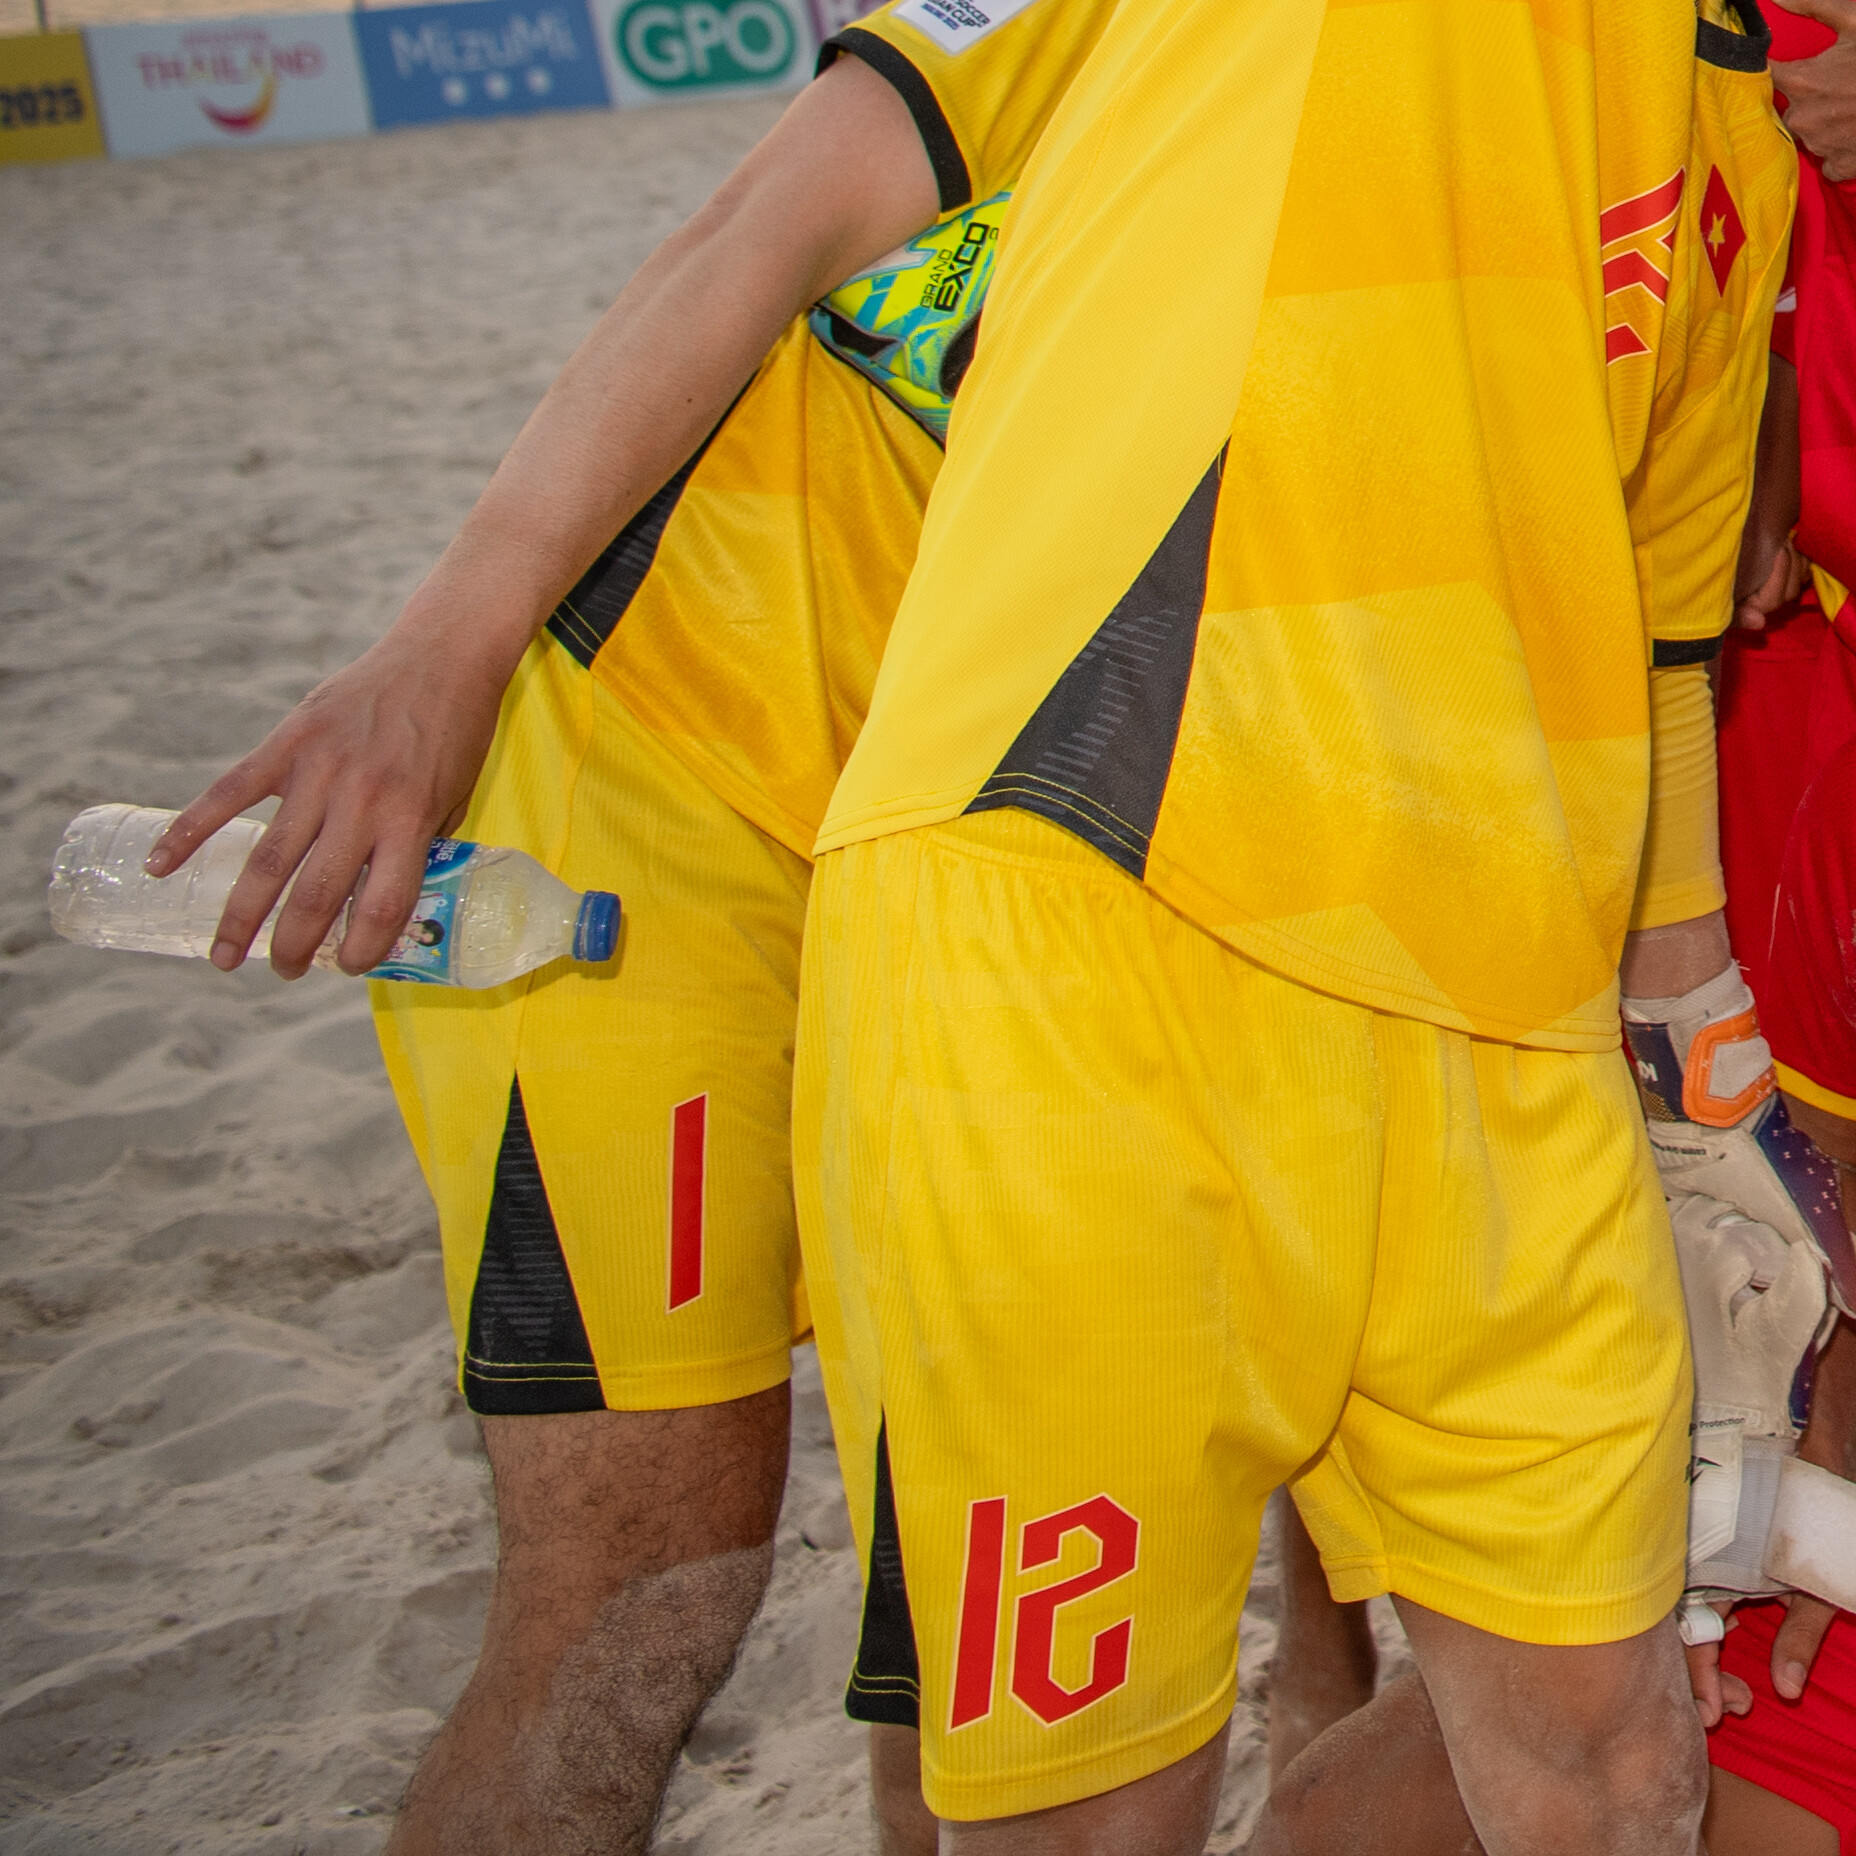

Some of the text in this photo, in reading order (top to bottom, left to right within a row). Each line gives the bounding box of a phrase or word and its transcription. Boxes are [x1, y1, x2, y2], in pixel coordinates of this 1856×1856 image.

[0, 78, 86, 131] 2025
[920, 249, 953, 309] GRAND
[665, 1091, 709, 1315] 1
[947, 1491, 1140, 1734] 12
